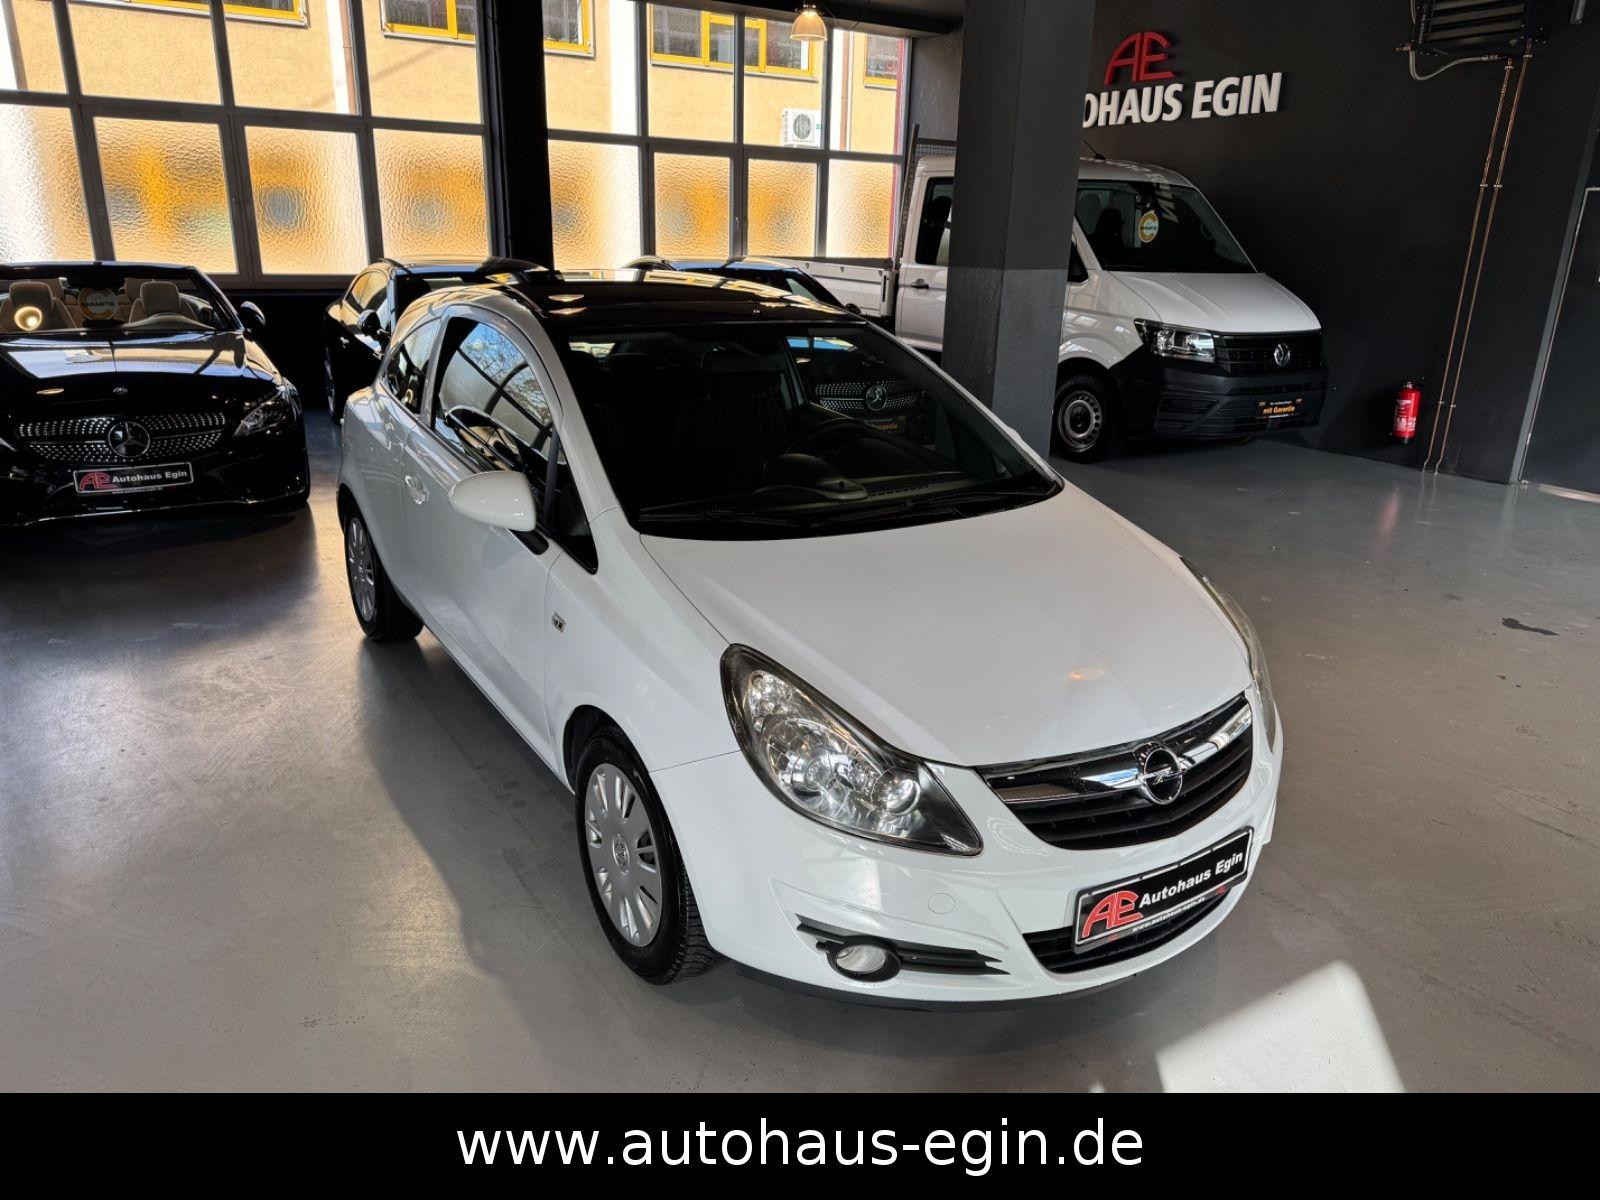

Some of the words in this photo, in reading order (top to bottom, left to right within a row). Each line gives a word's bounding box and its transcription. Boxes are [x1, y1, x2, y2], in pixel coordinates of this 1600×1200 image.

[1104, 31, 1175, 86] AE
[1191, 72, 1283, 119] EGIN
[112, 473, 162, 483] Autohaus
[165, 470, 187, 479] Egin
[1138, 869, 1211, 909] Autohaus
[1215, 852, 1243, 875] Egin
[1081, 890, 1144, 938] AE
